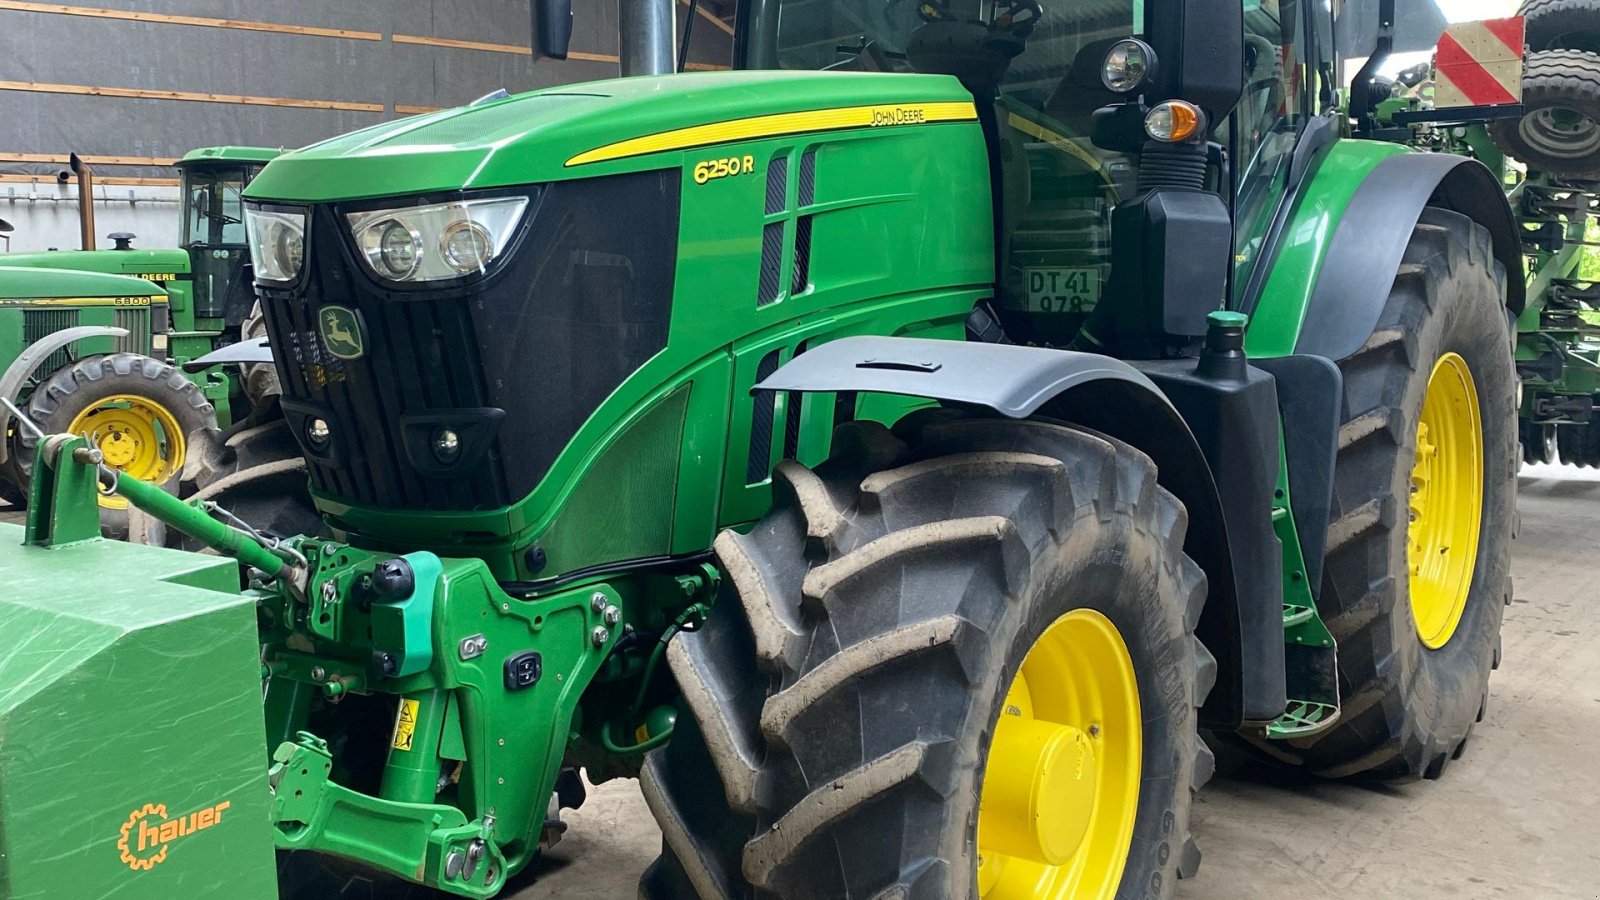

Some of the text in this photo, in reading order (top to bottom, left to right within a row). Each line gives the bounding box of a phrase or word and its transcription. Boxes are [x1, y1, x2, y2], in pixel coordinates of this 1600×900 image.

[870, 108, 925, 125] JOHN DEERE
[142, 273, 176, 281] DEERE
[114, 297, 149, 305] 6800
[137, 800, 230, 852] hauer
